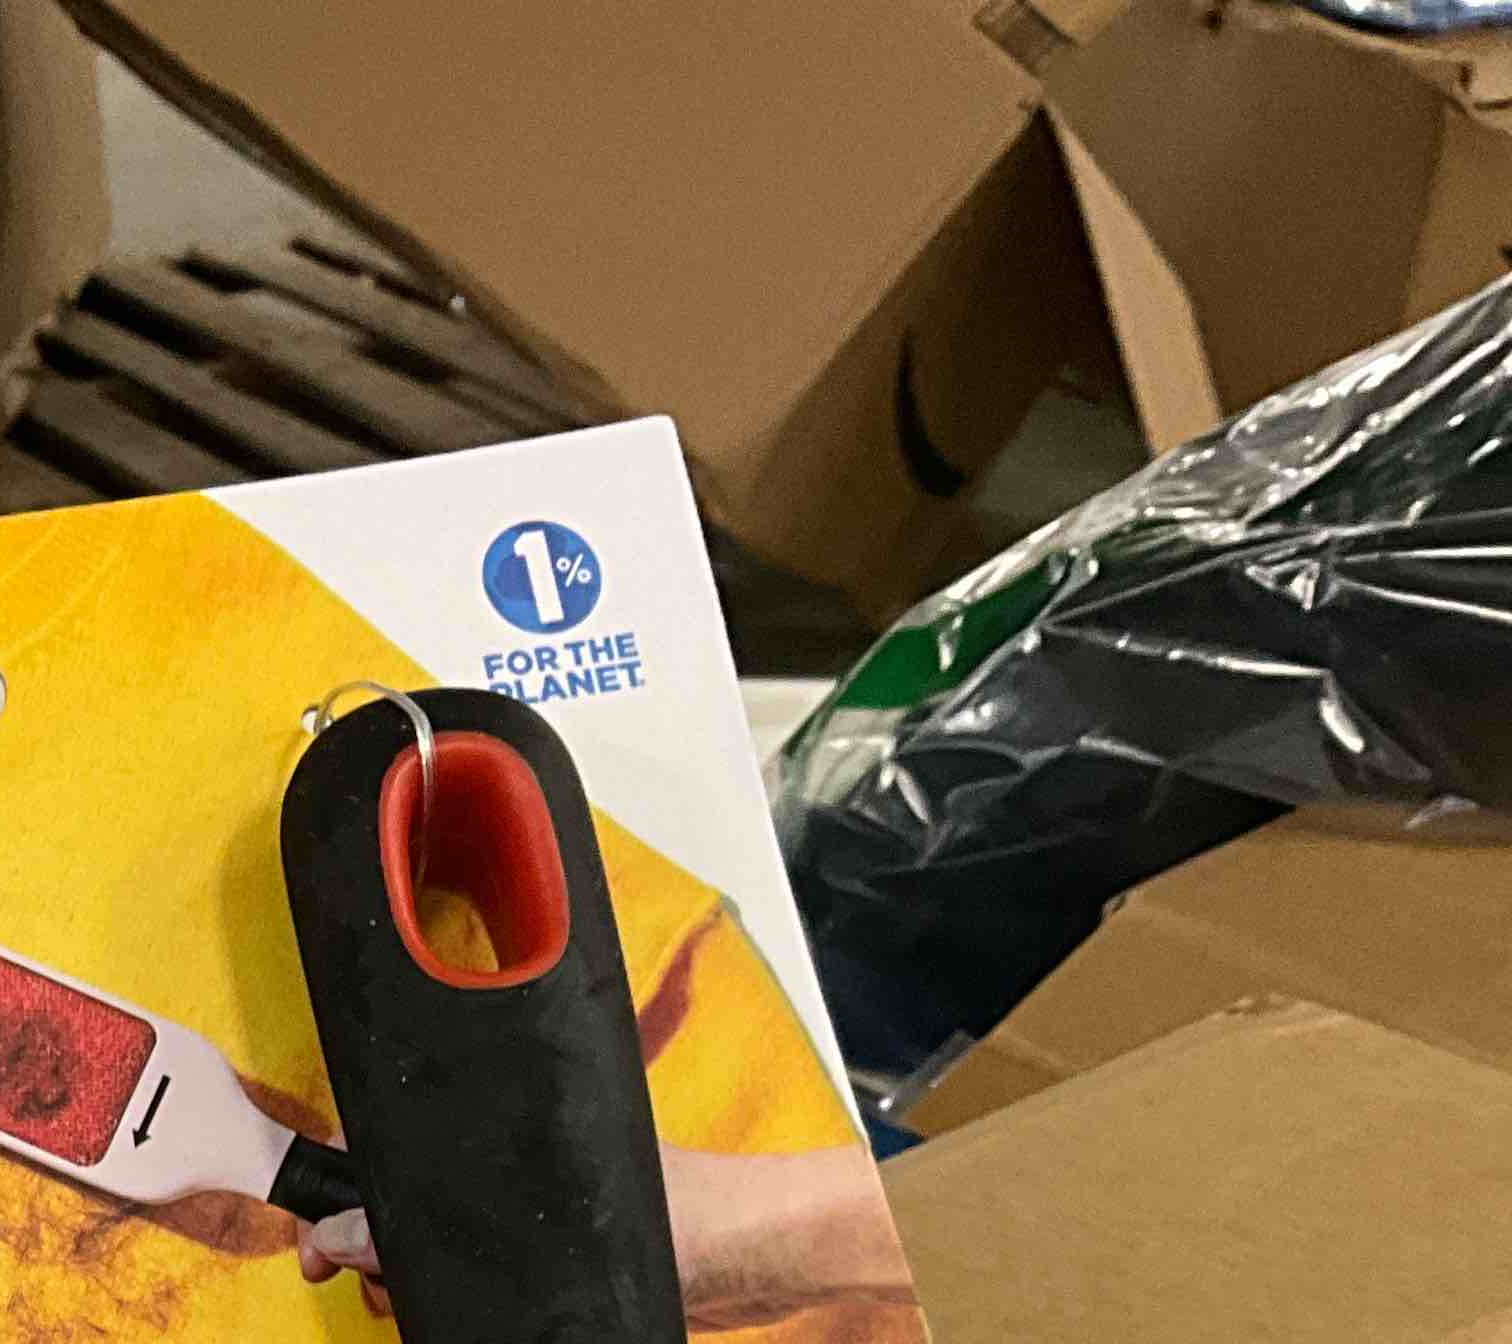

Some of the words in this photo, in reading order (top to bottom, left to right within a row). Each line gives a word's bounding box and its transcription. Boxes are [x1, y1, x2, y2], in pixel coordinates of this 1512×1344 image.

[513, 529, 592, 625] 1%
[482, 646, 561, 679] FOR
[563, 632, 639, 666] THE
